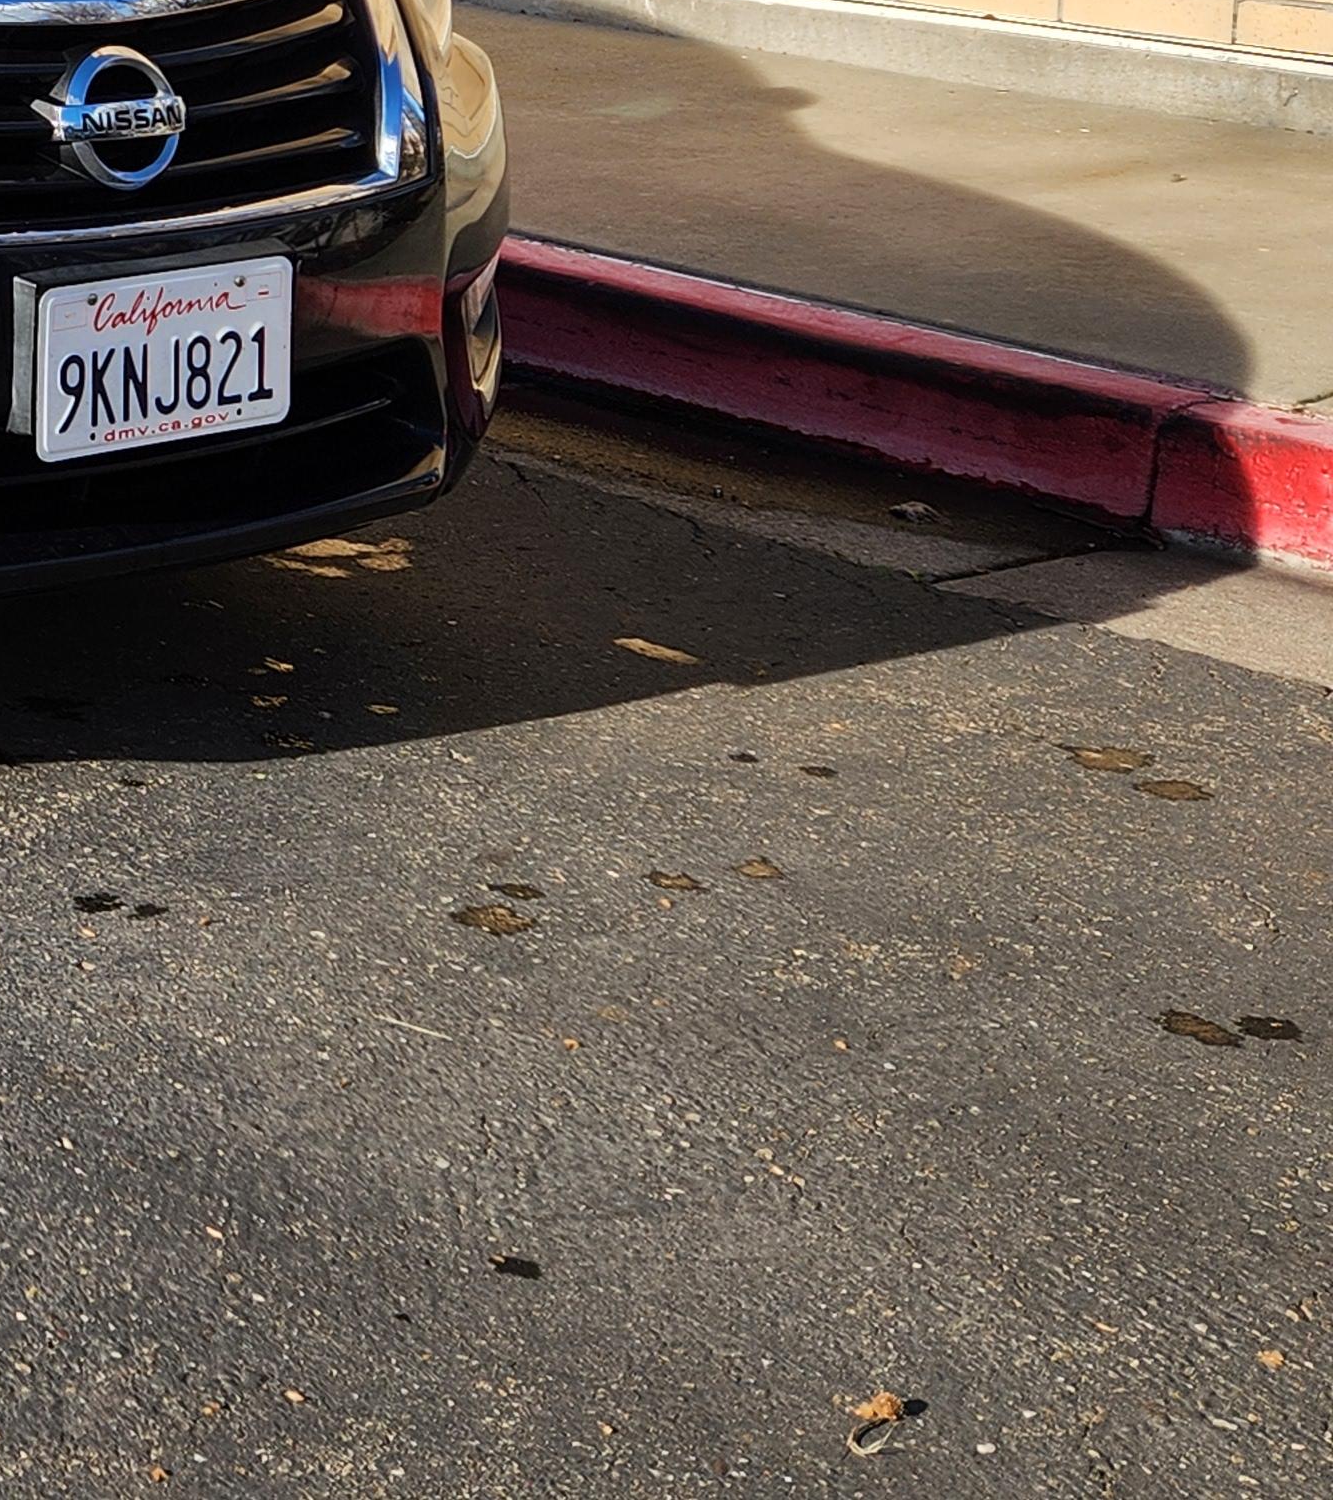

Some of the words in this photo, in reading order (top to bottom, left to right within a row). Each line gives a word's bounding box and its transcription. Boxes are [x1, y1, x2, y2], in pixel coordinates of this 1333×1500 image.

[81, 104, 183, 133] NISSAN
[93, 286, 246, 336] California
[56, 325, 273, 434] 9KNJ821
[104, 410, 230, 442] dmv.ca.gov
